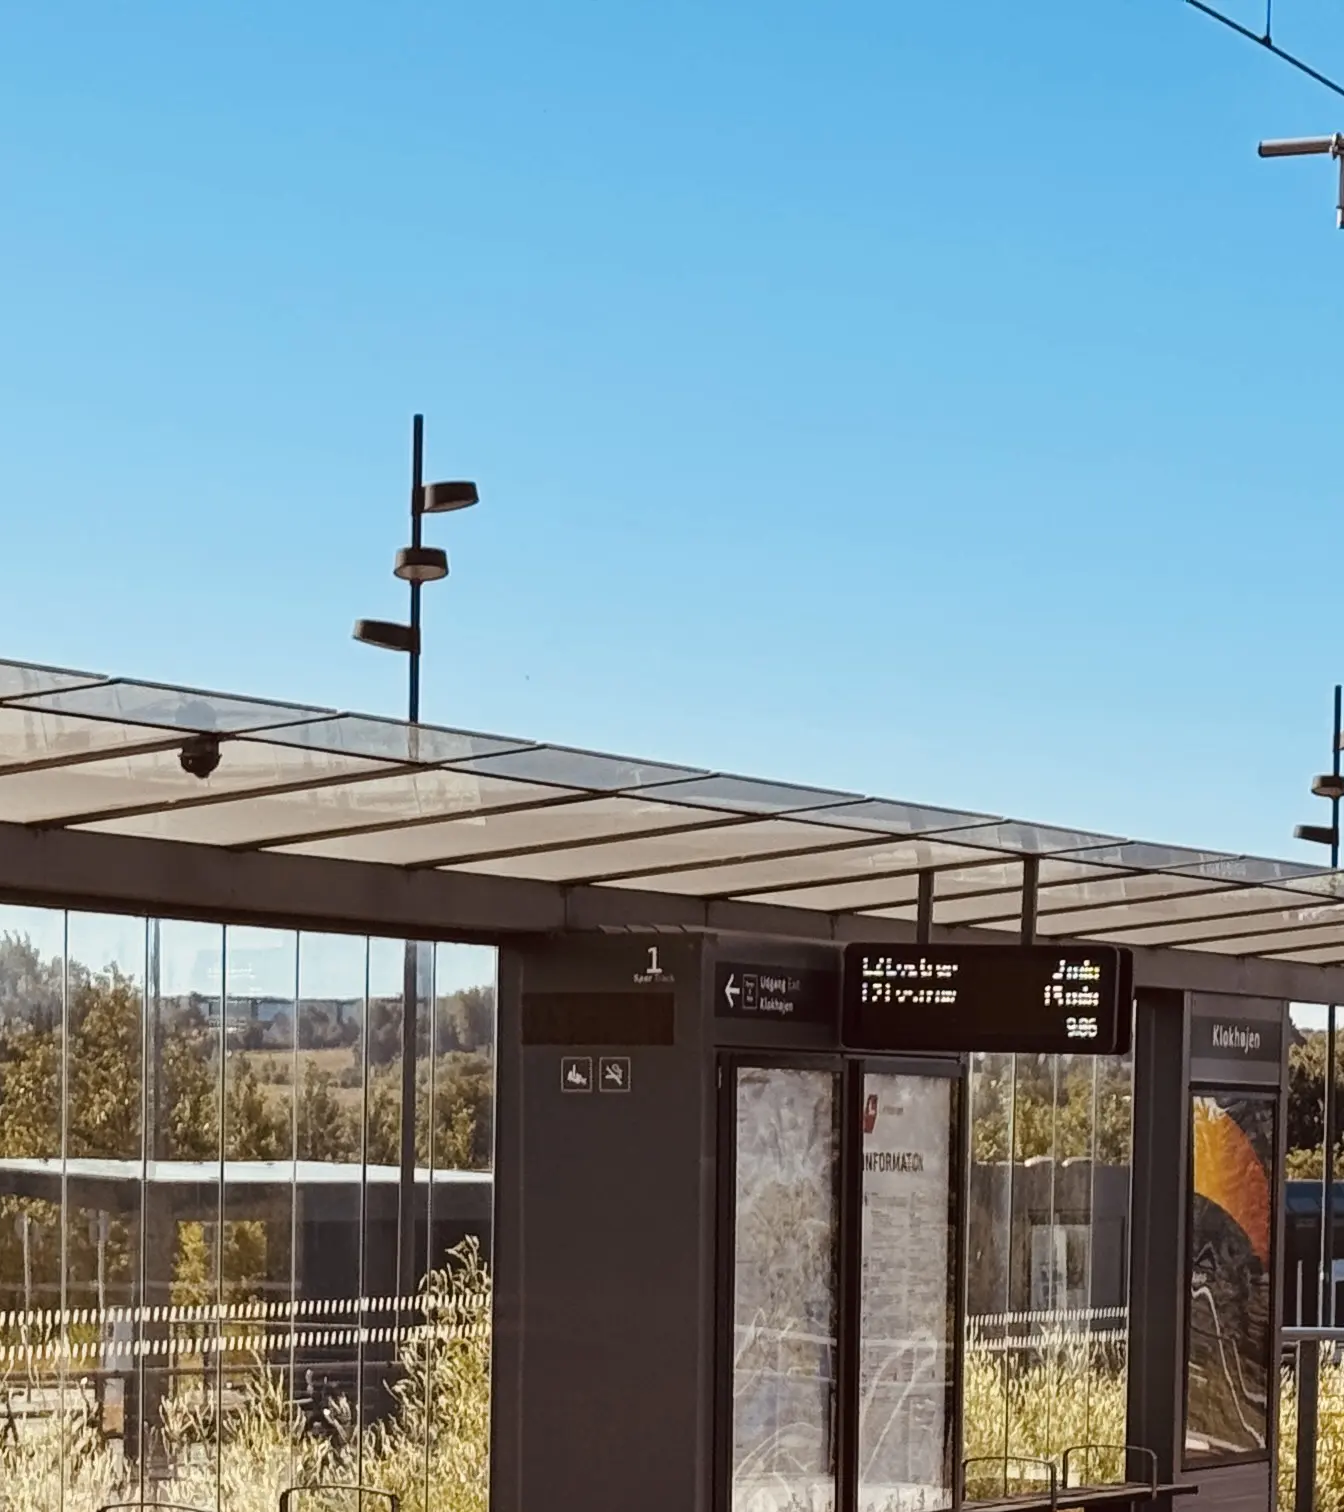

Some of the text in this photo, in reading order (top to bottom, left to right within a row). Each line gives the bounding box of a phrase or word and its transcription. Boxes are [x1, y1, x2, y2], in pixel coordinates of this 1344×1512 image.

[646, 946, 663, 974] 1
[760, 975, 786, 994] Udgang
[1212, 1024, 1261, 1054] Klokhøjen
